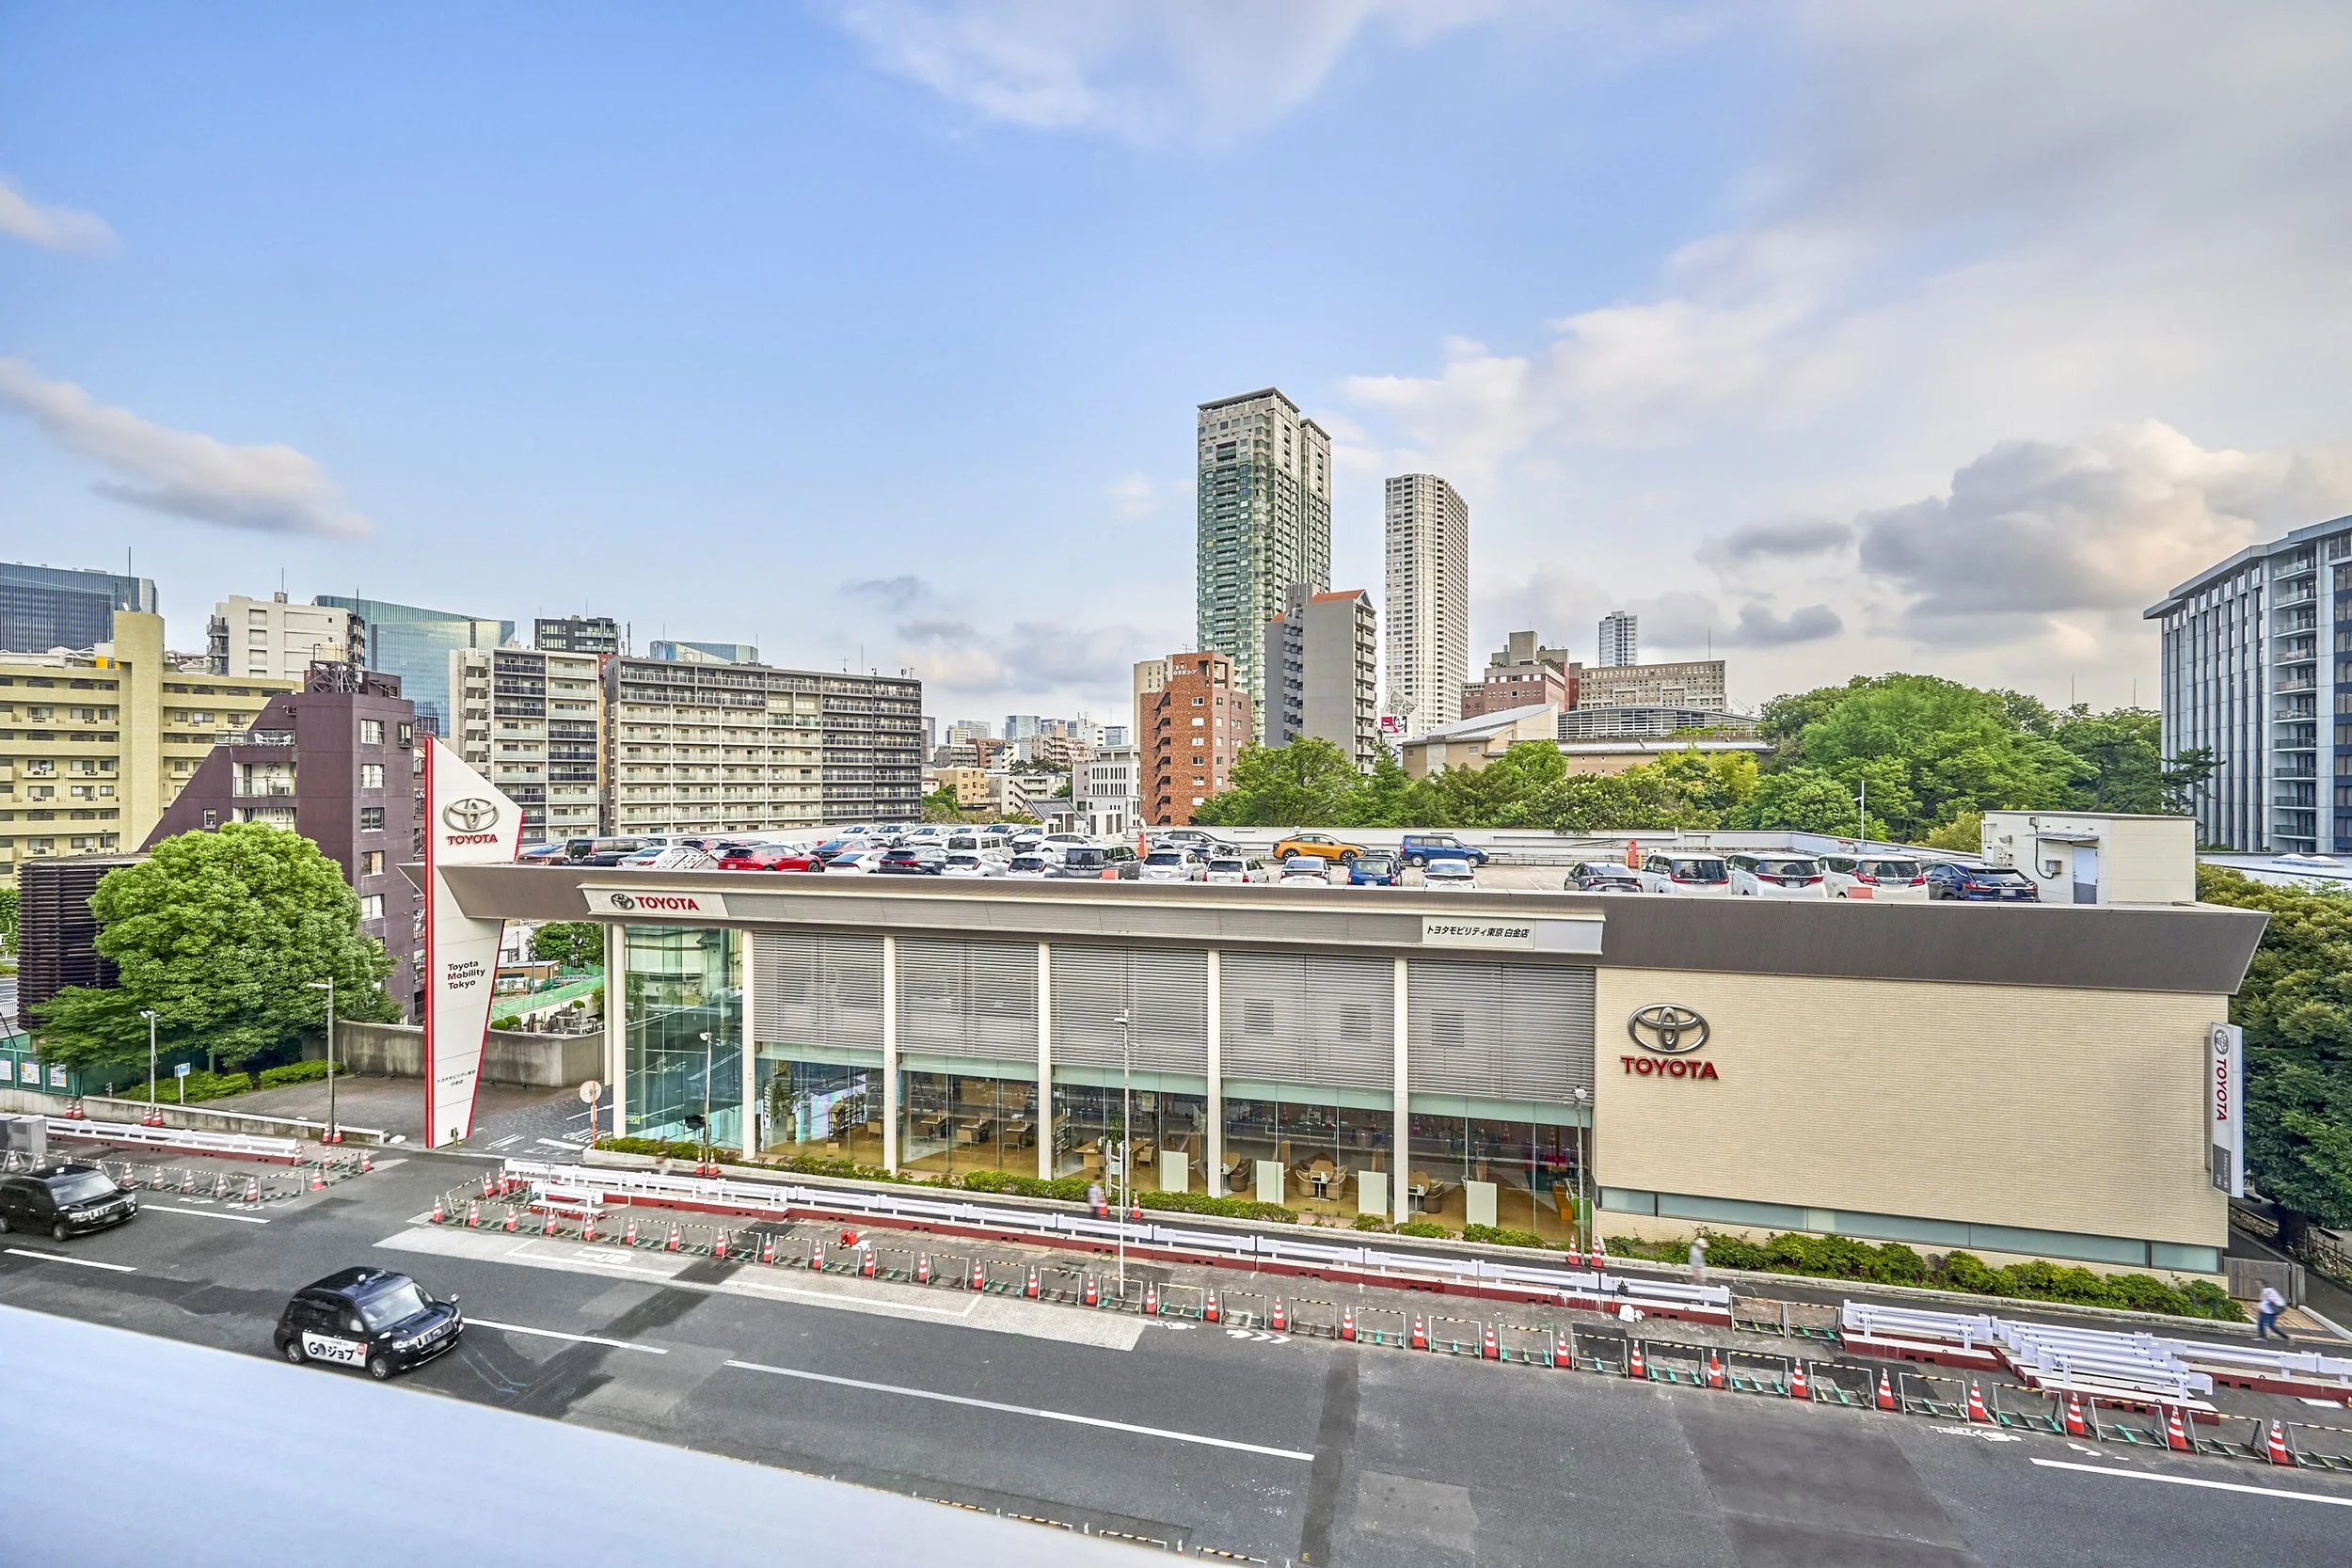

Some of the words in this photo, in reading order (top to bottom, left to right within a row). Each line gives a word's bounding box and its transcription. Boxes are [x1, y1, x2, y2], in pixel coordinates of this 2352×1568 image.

[447, 833, 498, 846] TOYOTA
[635, 896, 700, 911] TOYOTA
[1427, 926, 1504, 937] トヨタモビリティ東京
[1504, 928, 1530, 939] 白金店
[448, 960, 479, 972] Toyota
[447, 969, 485, 980] Mobility
[448, 980, 476, 990] Tokyo
[1620, 1055, 1719, 1081] TOYOTA
[2217, 1059, 2227, 1121] TOYOTA
